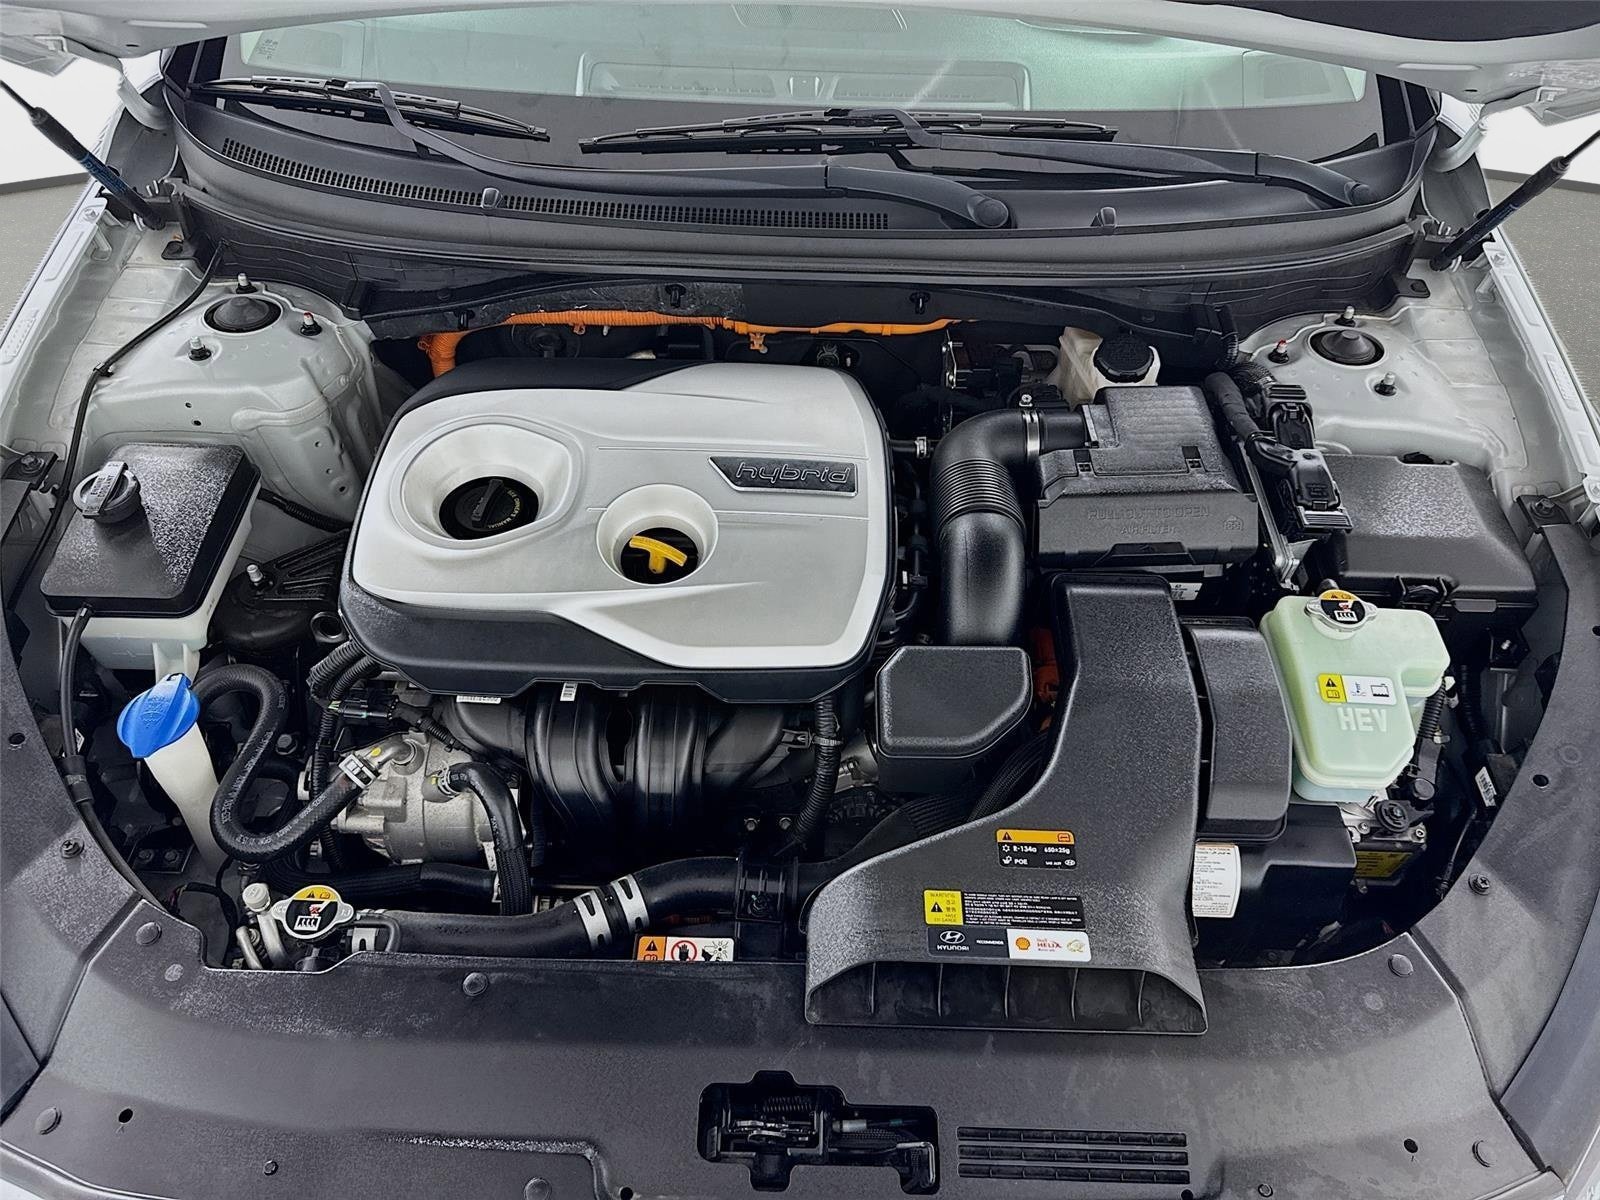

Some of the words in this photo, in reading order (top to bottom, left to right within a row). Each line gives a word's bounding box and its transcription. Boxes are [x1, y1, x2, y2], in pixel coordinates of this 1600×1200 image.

[735, 461, 851, 484] hybrid
[1175, 505, 1209, 518] OPEN
[1337, 706, 1390, 732] HEV
[1036, 940, 1062, 949] HELIX
